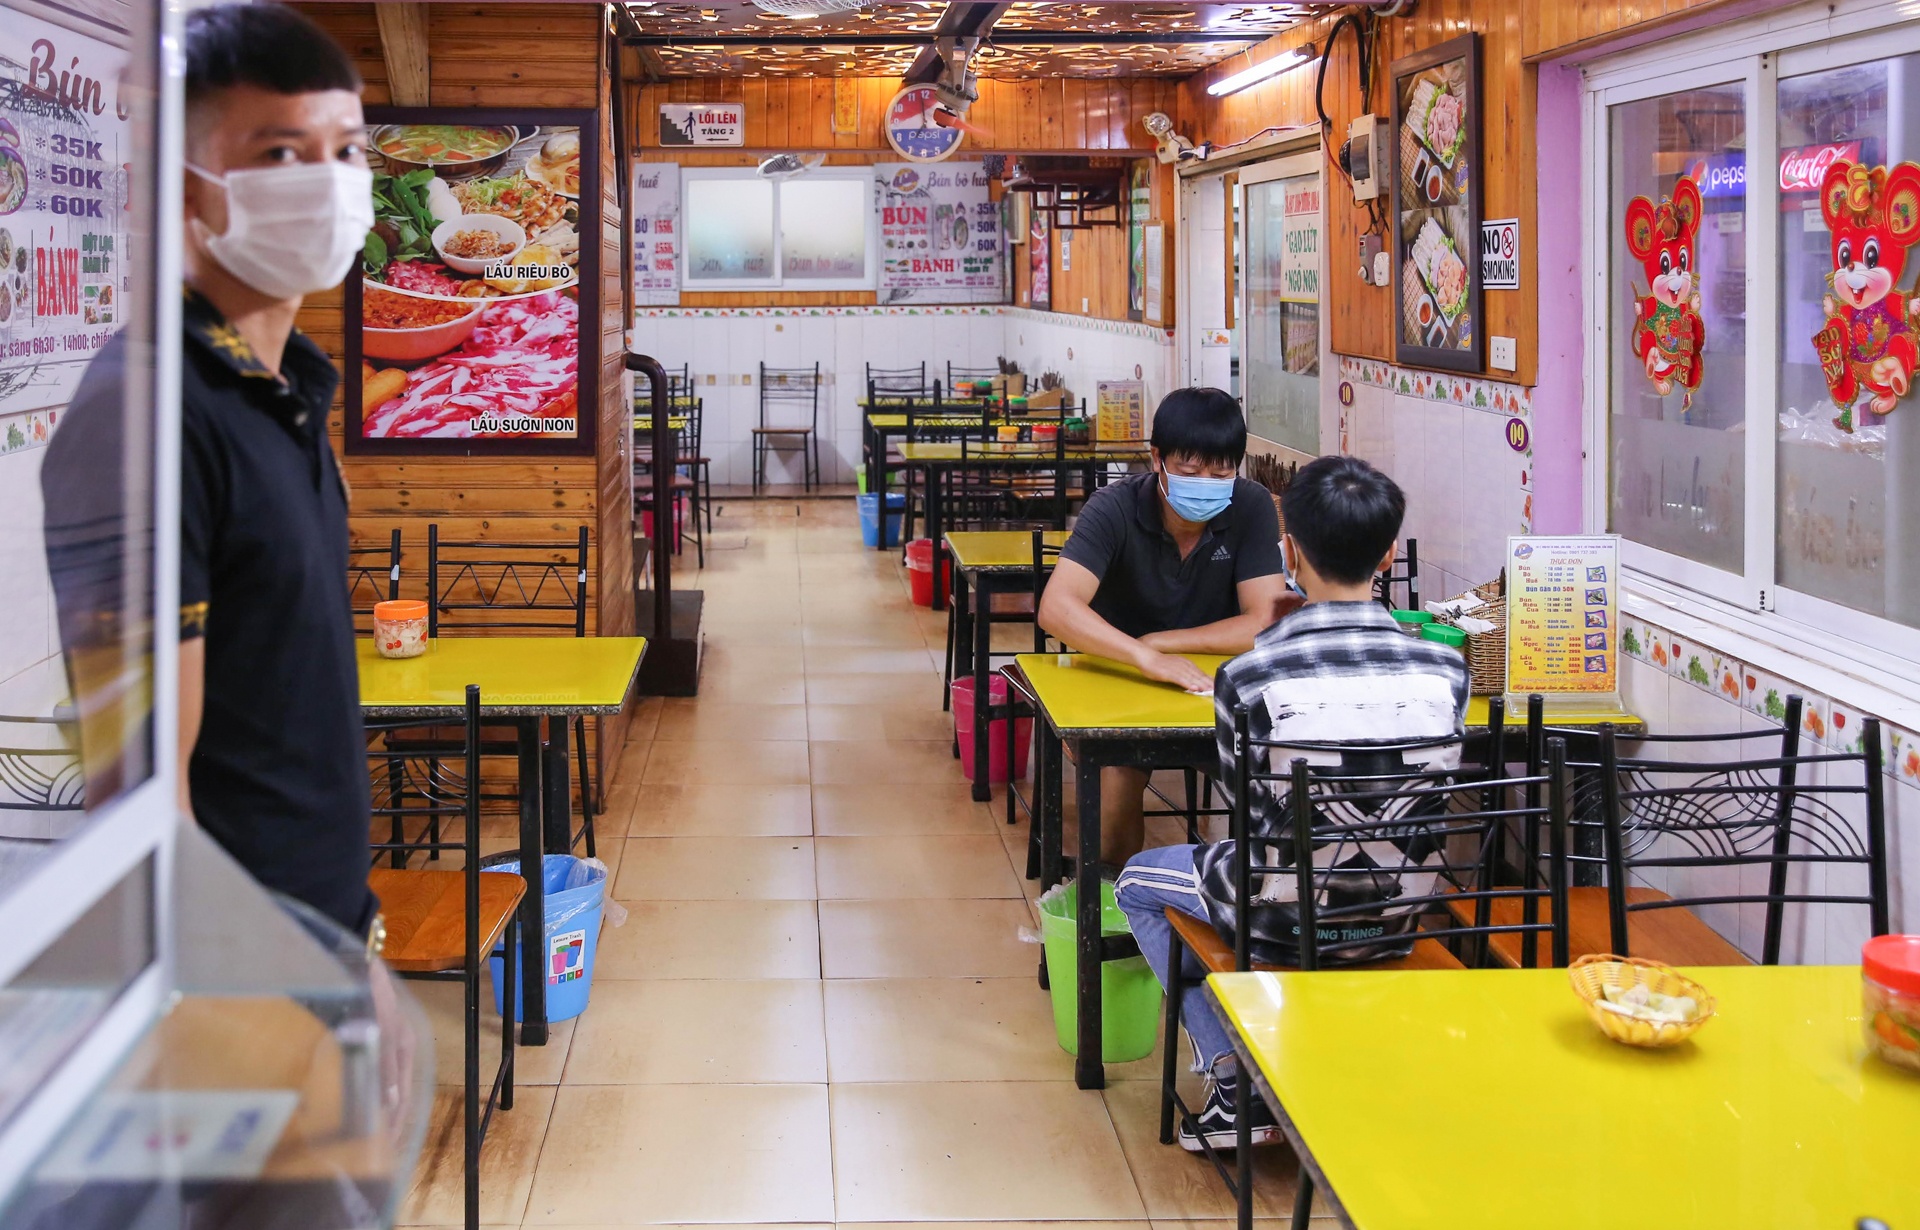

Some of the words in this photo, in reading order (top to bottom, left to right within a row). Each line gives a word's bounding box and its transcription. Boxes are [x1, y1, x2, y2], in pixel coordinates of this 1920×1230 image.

[22, 38, 106, 116] Bún
[907, 92, 916, 102] 11
[920, 89, 930, 100] 12
[699, 109, 715, 124] LỐI
[718, 111, 737, 124] LÊN
[51, 134, 103, 161] 35K
[51, 164, 103, 190] 50K
[927, 171, 953, 188] Bún
[51, 195, 103, 218] 60K
[882, 201, 928, 225] BÚN
[977, 203, 996, 215] 35K
[977, 221, 997, 233] 50K
[978, 239, 997, 251] 60K
[1483, 229, 1500, 254] NO
[36, 225, 79, 316] BÁNH
[1483, 260, 1515, 280] SMOKING
[9, 338, 31, 357] sáng
[33, 336, 55, 354] 6h30
[62, 333, 90, 351] 14h00;
[1342, 385, 1350, 403] 10
[1510, 422, 1525, 447] 09
[1291, 925, 1338, 941] SING
[1341, 926, 1384, 941] THINGS
